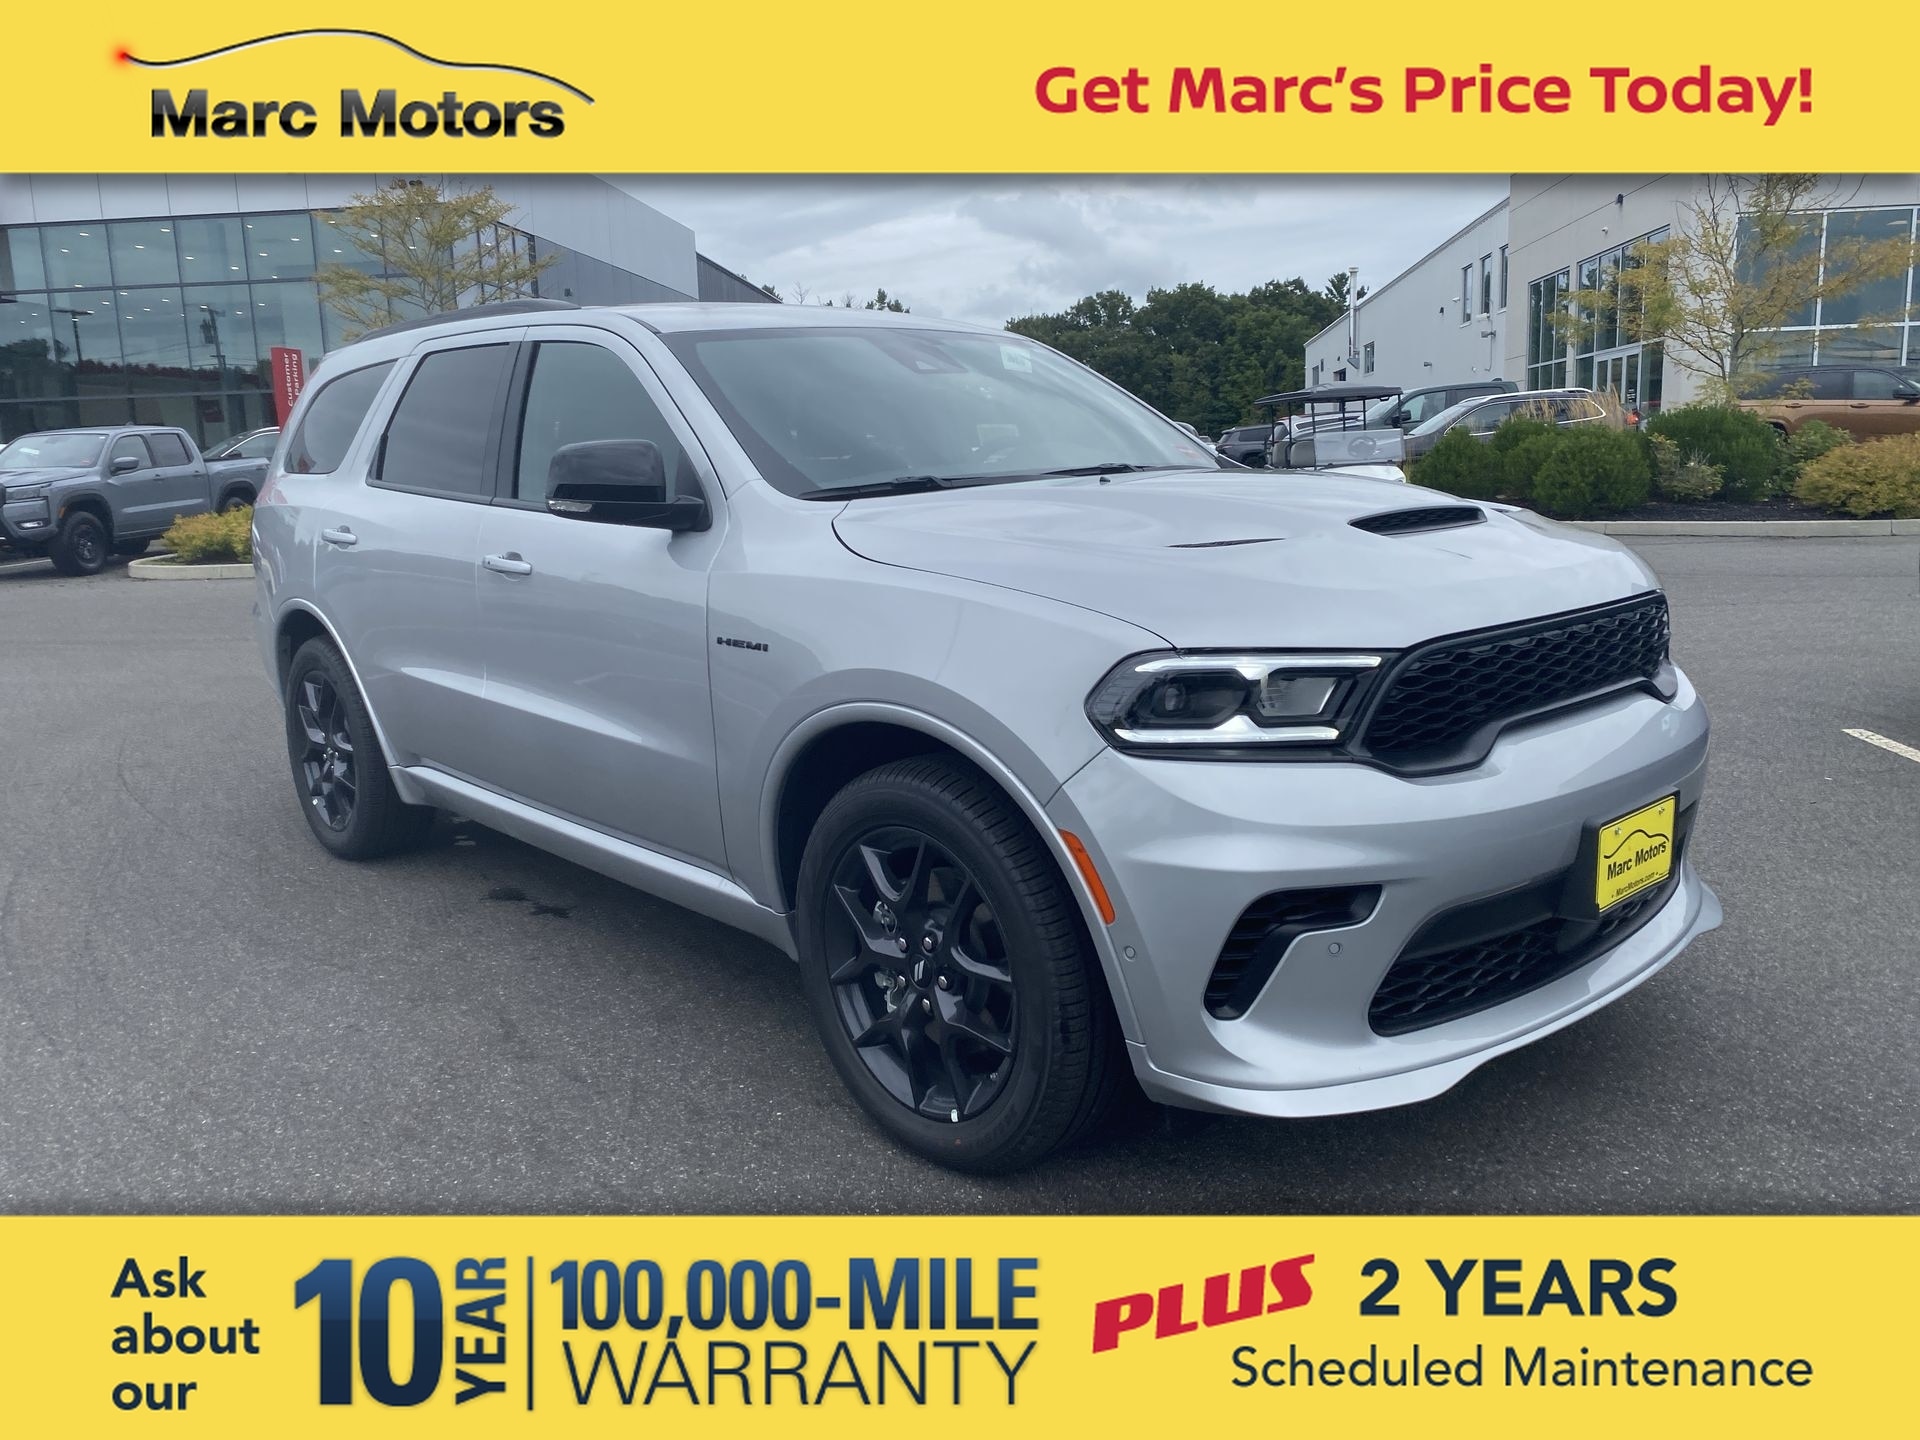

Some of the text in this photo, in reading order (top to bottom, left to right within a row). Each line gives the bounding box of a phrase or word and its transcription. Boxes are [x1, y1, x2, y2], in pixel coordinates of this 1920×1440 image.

[283, 352, 294, 407] Customer
[716, 636, 769, 652] HEMI
[1607, 841, 1667, 880] Marc Motors
